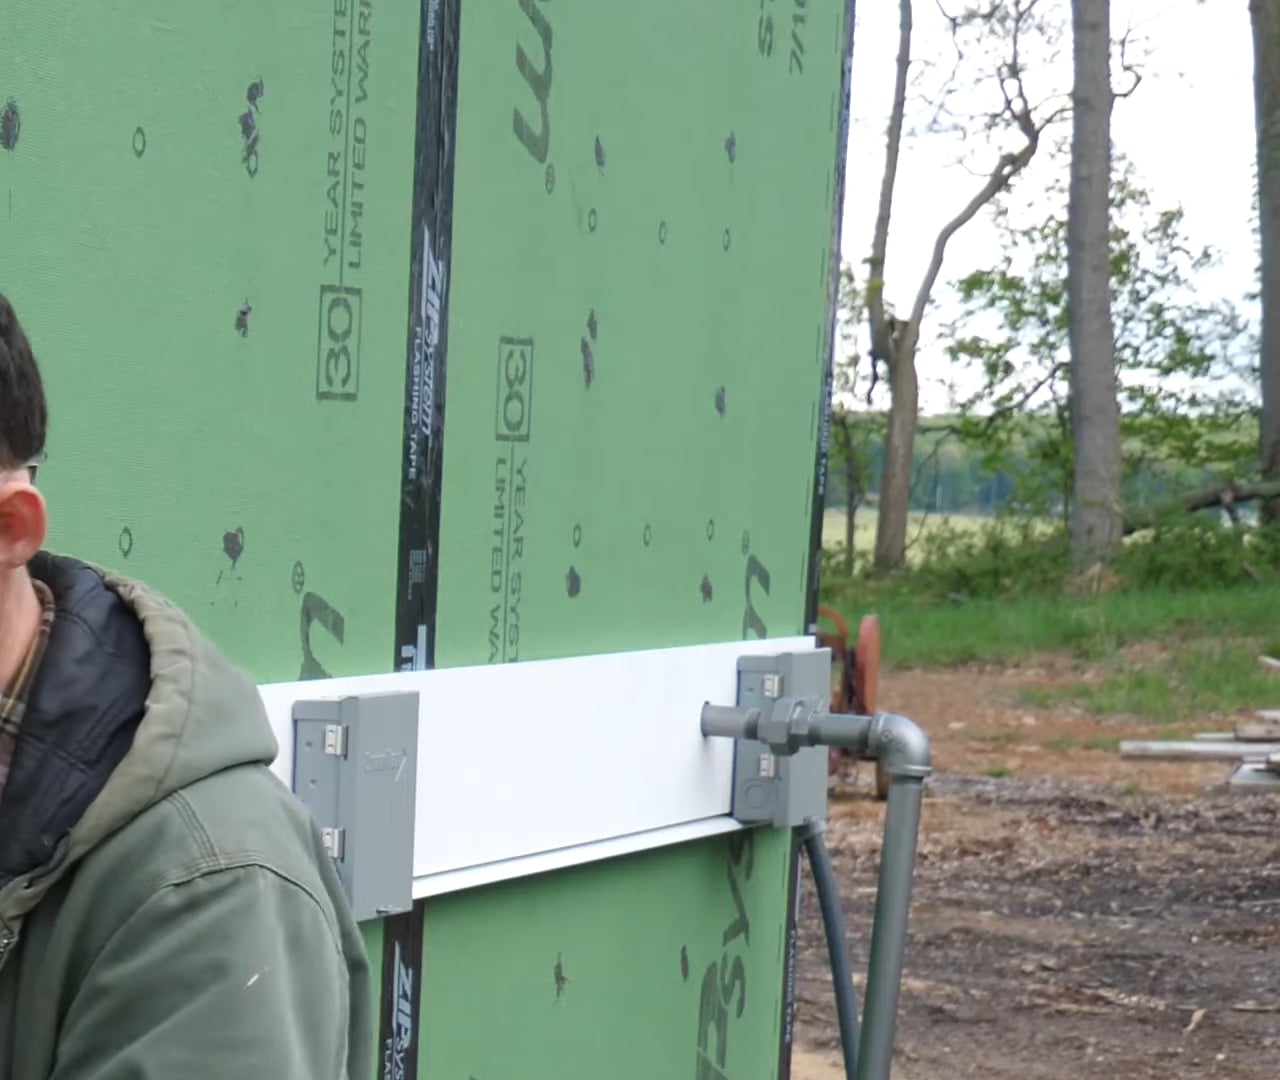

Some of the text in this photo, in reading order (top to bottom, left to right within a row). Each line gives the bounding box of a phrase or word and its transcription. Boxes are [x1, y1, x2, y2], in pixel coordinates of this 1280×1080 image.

[323, 151, 342, 267] YEAR
[348, 116, 368, 269] LIMITED
[325, 294, 354, 390] 30
[502, 349, 527, 433] 30
[408, 326, 423, 480] FLASHING TAPE
[490, 457, 508, 594] LIMITED
[512, 456, 528, 560] YEAR
